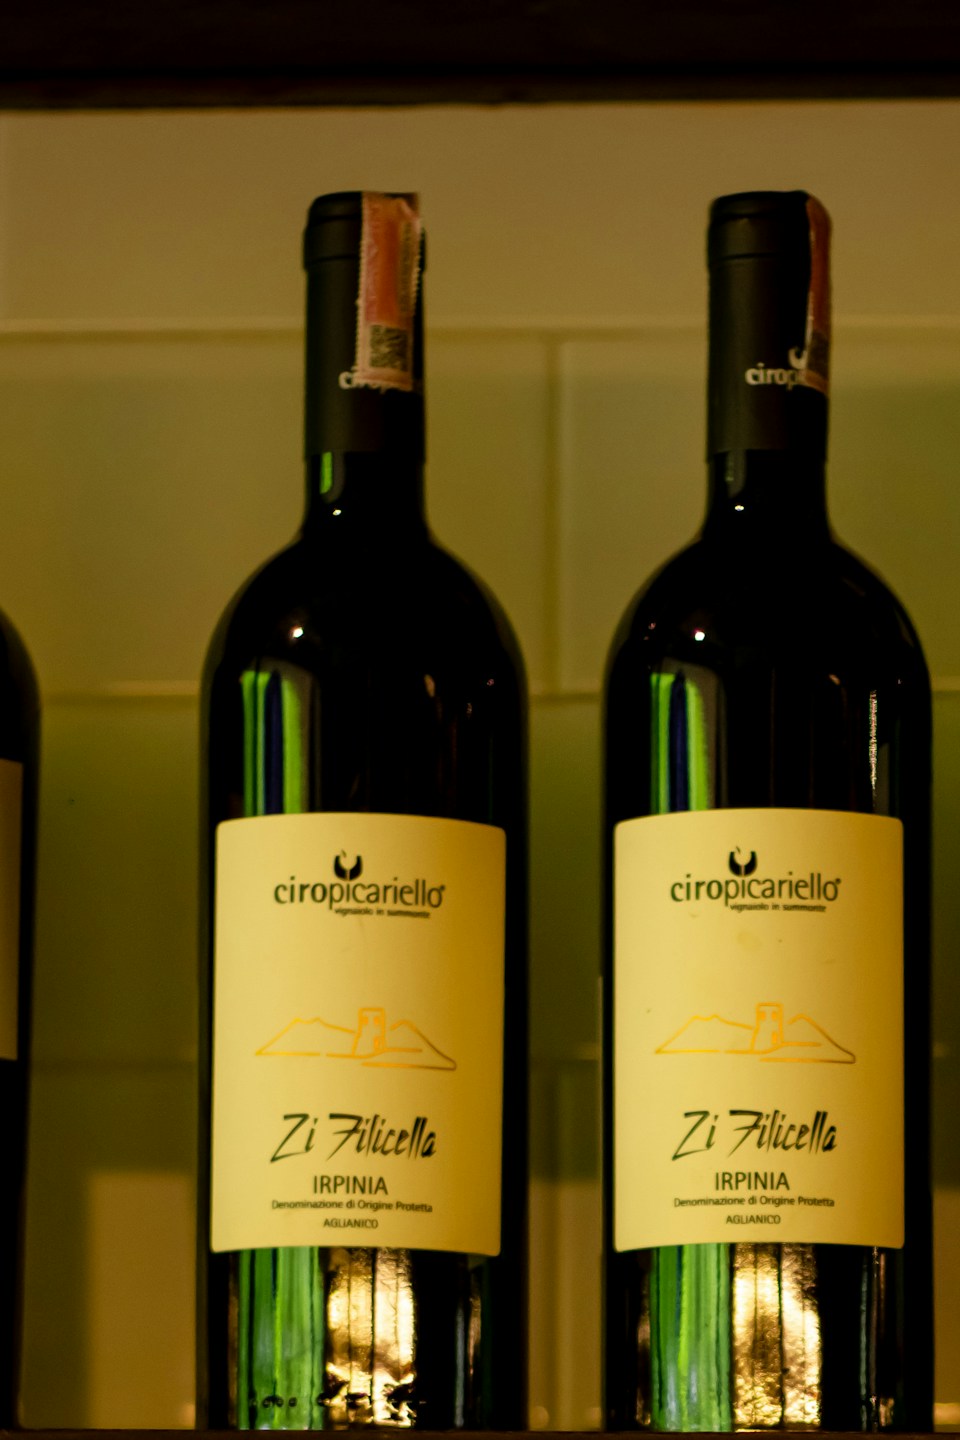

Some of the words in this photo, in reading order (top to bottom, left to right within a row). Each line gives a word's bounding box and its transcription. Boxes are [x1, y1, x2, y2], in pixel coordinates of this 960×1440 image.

[274, 877, 443, 909] ciropicariello
[670, 871, 839, 906] ciropicariello
[270, 1113, 319, 1163] Zi
[326, 1113, 437, 1161] Filicella
[672, 1110, 720, 1161] Zi
[727, 1110, 838, 1158] Filicella
[313, 1175, 389, 1196] IRPINIA
[714, 1172, 790, 1191] IRPINIA
[271, 1199, 344, 1211] Denominazione
[346, 1199, 356, 1210] di
[358, 1199, 394, 1213] Origine
[396, 1201, 433, 1213] Protetta
[674, 1197, 745, 1208] Denominazione
[748, 1196, 757, 1207] di
[759, 1196, 795, 1209] Origine
[797, 1196, 835, 1208] Protetta
[323, 1218, 379, 1229] AGLIANICO
[725, 1214, 781, 1225] AGLIANICO
